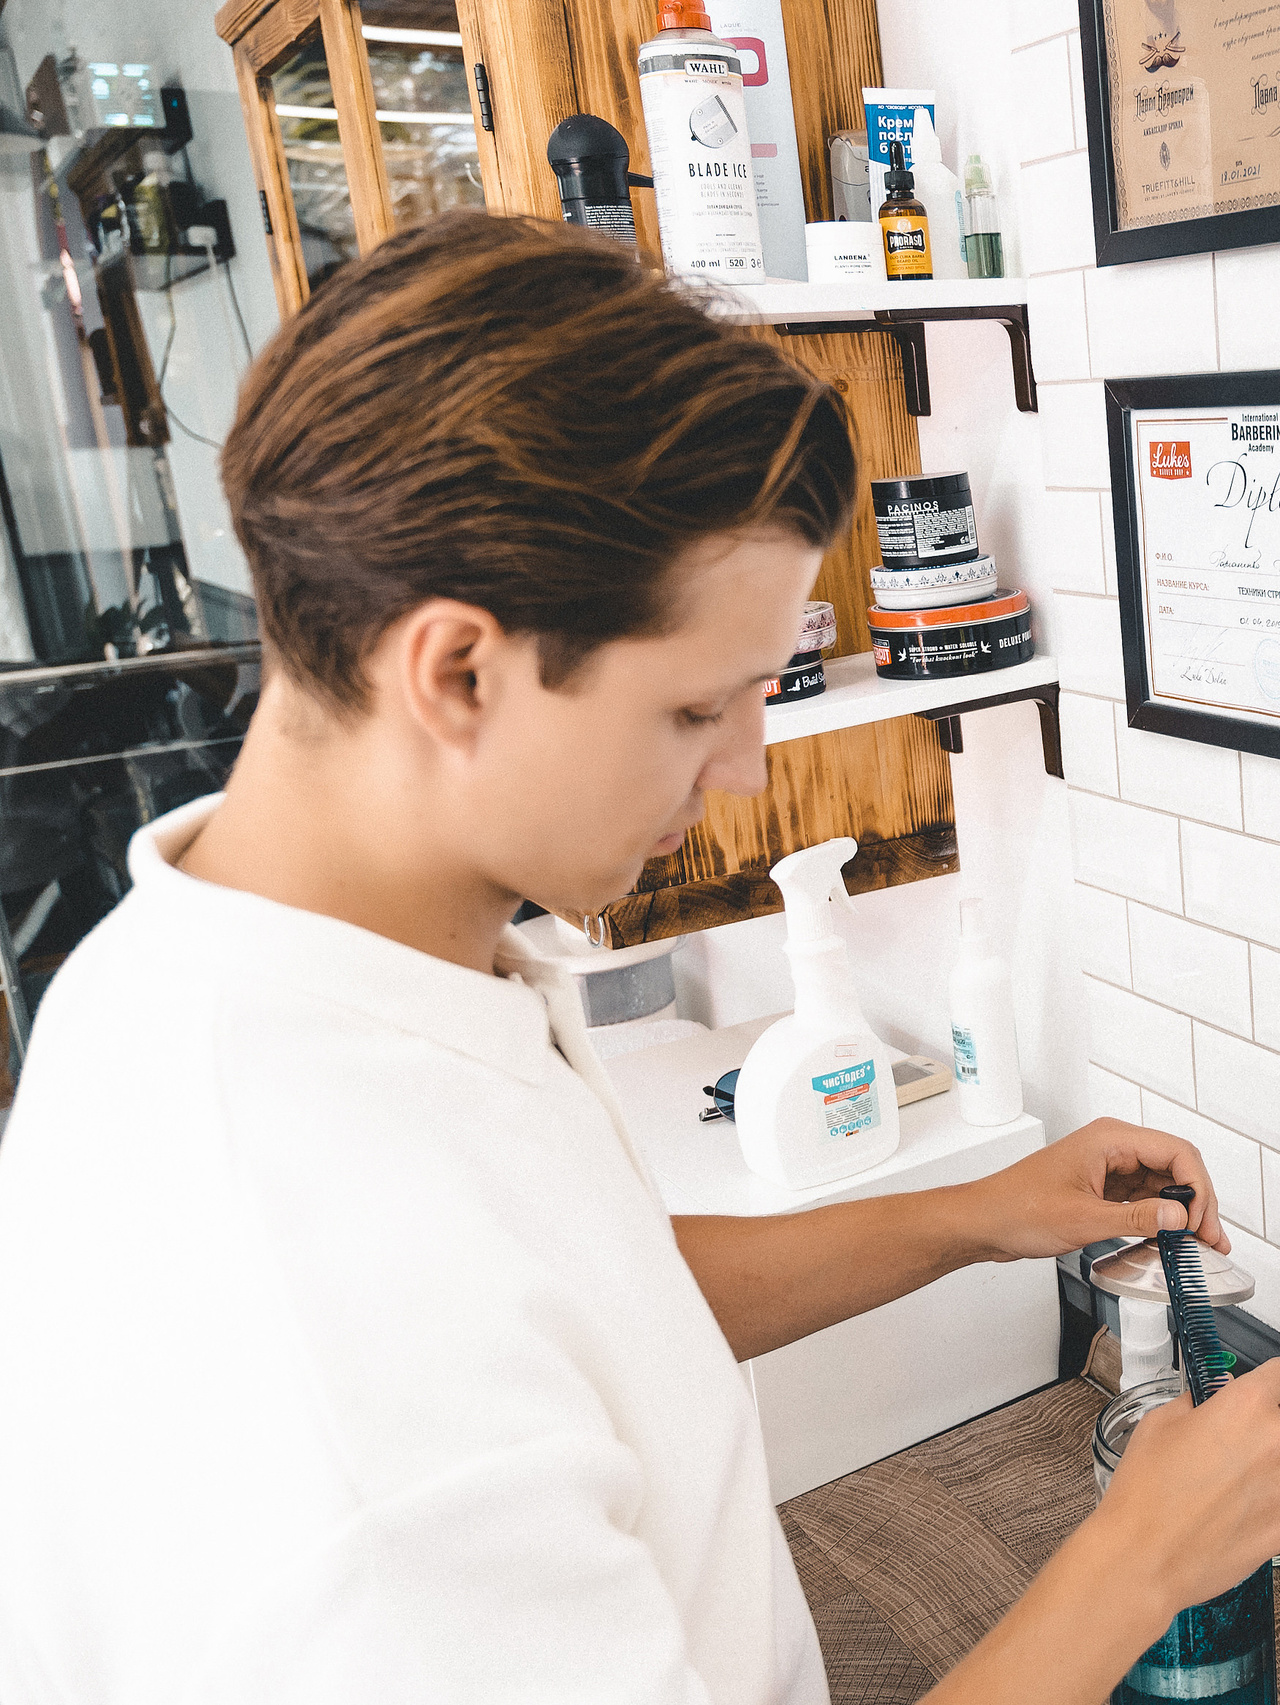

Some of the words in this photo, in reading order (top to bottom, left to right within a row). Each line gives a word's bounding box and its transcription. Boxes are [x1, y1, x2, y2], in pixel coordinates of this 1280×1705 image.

[689, 62, 725, 75] WAHL
[877, 115, 914, 130] Крем
[878, 131, 914, 142] посл
[688, 162, 729, 178] BLADE
[732, 163, 748, 179] ICE
[889, 233, 923, 248] PRORASO
[690, 259, 706, 269] 400
[708, 259, 721, 268] ml
[729, 258, 744, 267] 520
[1241, 412, 1279, 424] International
[1152, 443, 1190, 468] Luke's
[1247, 442, 1275, 454] Academy
[887, 500, 939, 514] PACINOS
[1156, 578, 1188, 590] НАЗВАНИЕ
[1237, 586, 1267, 598] ТЕХНИКИ
[998, 633, 1022, 649] DELUXE
[822, 1068, 866, 1089] ЧИСТОДЕЗ
